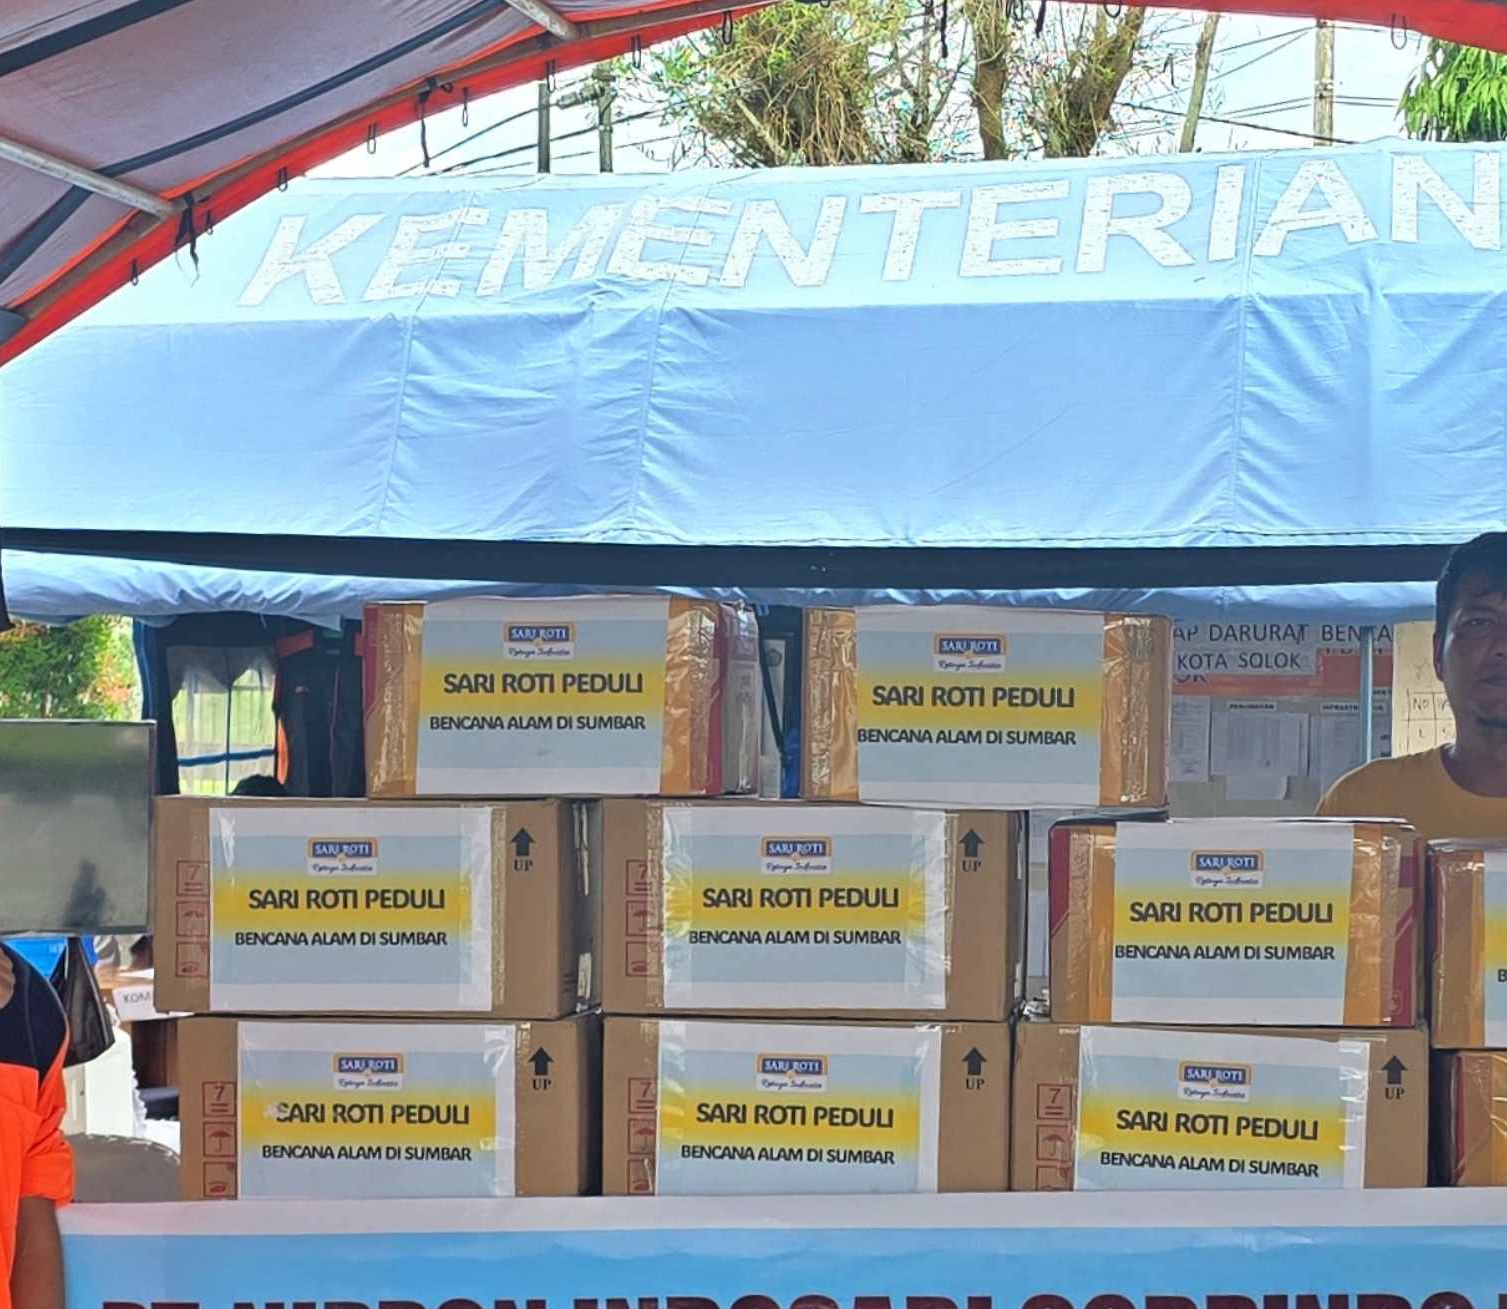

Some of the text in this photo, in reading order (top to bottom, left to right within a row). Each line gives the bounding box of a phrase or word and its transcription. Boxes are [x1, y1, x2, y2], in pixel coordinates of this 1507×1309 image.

[238, 150, 1501, 307] KEMENTERIAN
[510, 627, 567, 640] SARI ROTI
[1209, 624, 1309, 642] DARURAT
[1177, 652, 1301, 670] KOTA SOLOK
[444, 672, 642, 693] SARI ROTI PEDULI
[429, 715, 645, 730] BENCANA ALAM DI SUMBAR
[513, 860, 533, 871] UP
[962, 860, 982, 871] UP
[1198, 857, 1255, 868] SARI ROTI
[249, 888, 444, 909] SARI ROTI PEDULI
[235, 931, 447, 945] BENCANA ALAM DI SUMBAR
[532, 1078, 551, 1089] UP
[1384, 1088, 1405, 1100] UP
[696, 1102, 893, 1128] SARI ROTI PEDULI
[681, 1144, 894, 1164] BENCANA ALAM DI SUMBAR
